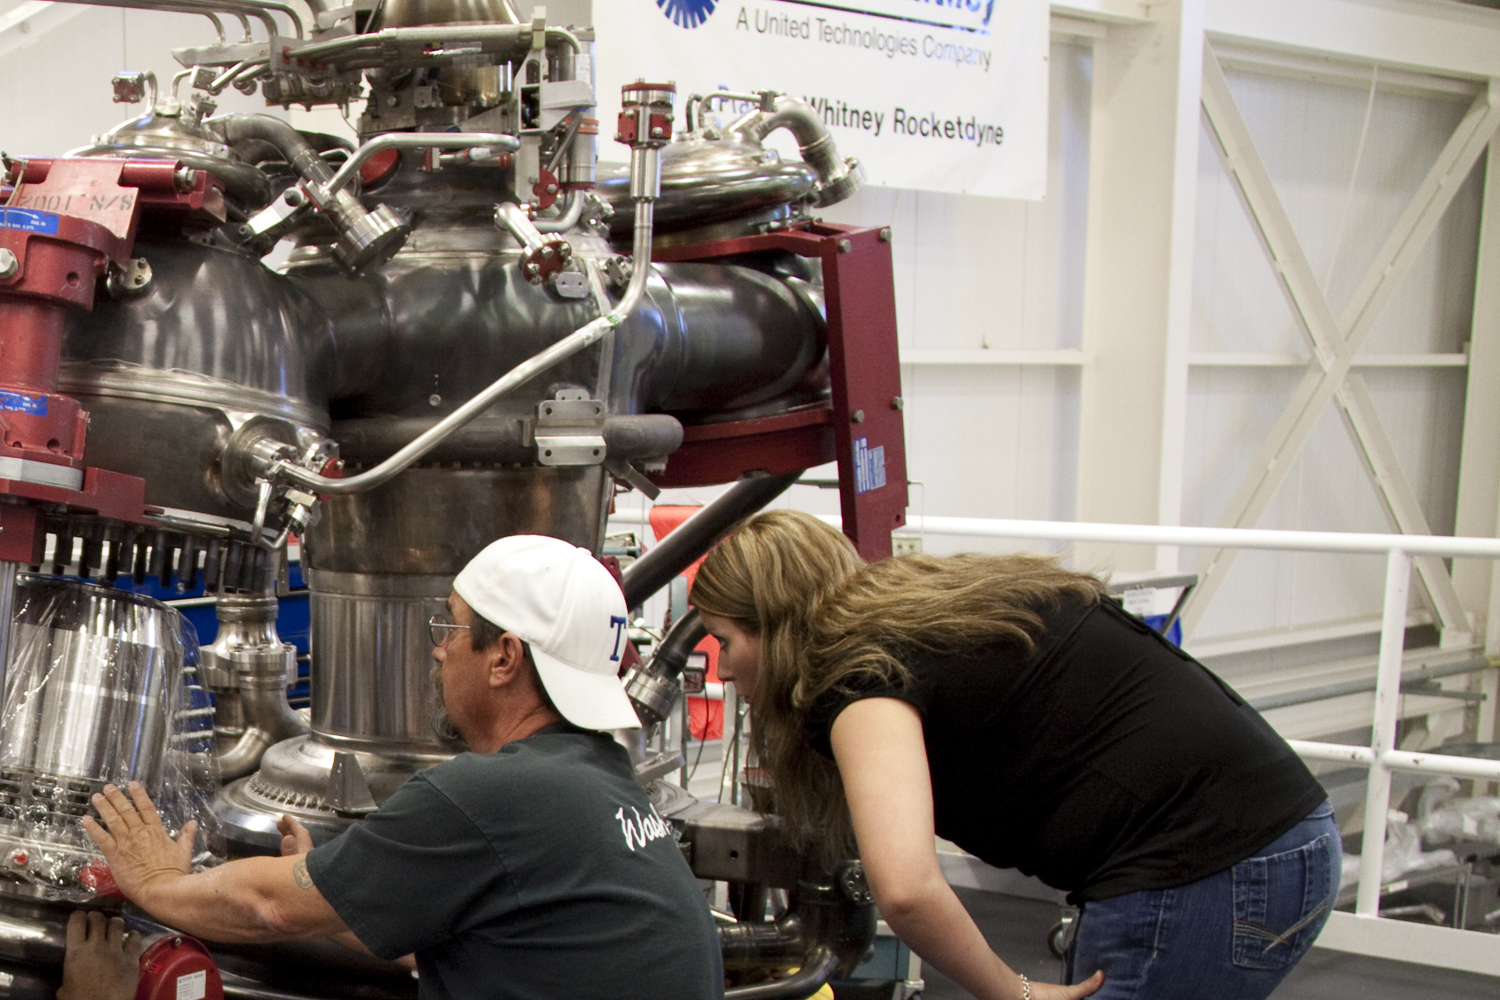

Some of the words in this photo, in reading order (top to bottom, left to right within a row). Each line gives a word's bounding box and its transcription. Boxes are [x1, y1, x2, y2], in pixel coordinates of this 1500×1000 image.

[736, 6, 749, 32] A
[754, 9, 811, 40] United
[815, 17, 918, 58] Technologies
[922, 34, 993, 72] Company
[893, 107, 1004, 147] Rocketdyne
[610, 615, 627, 662] T
